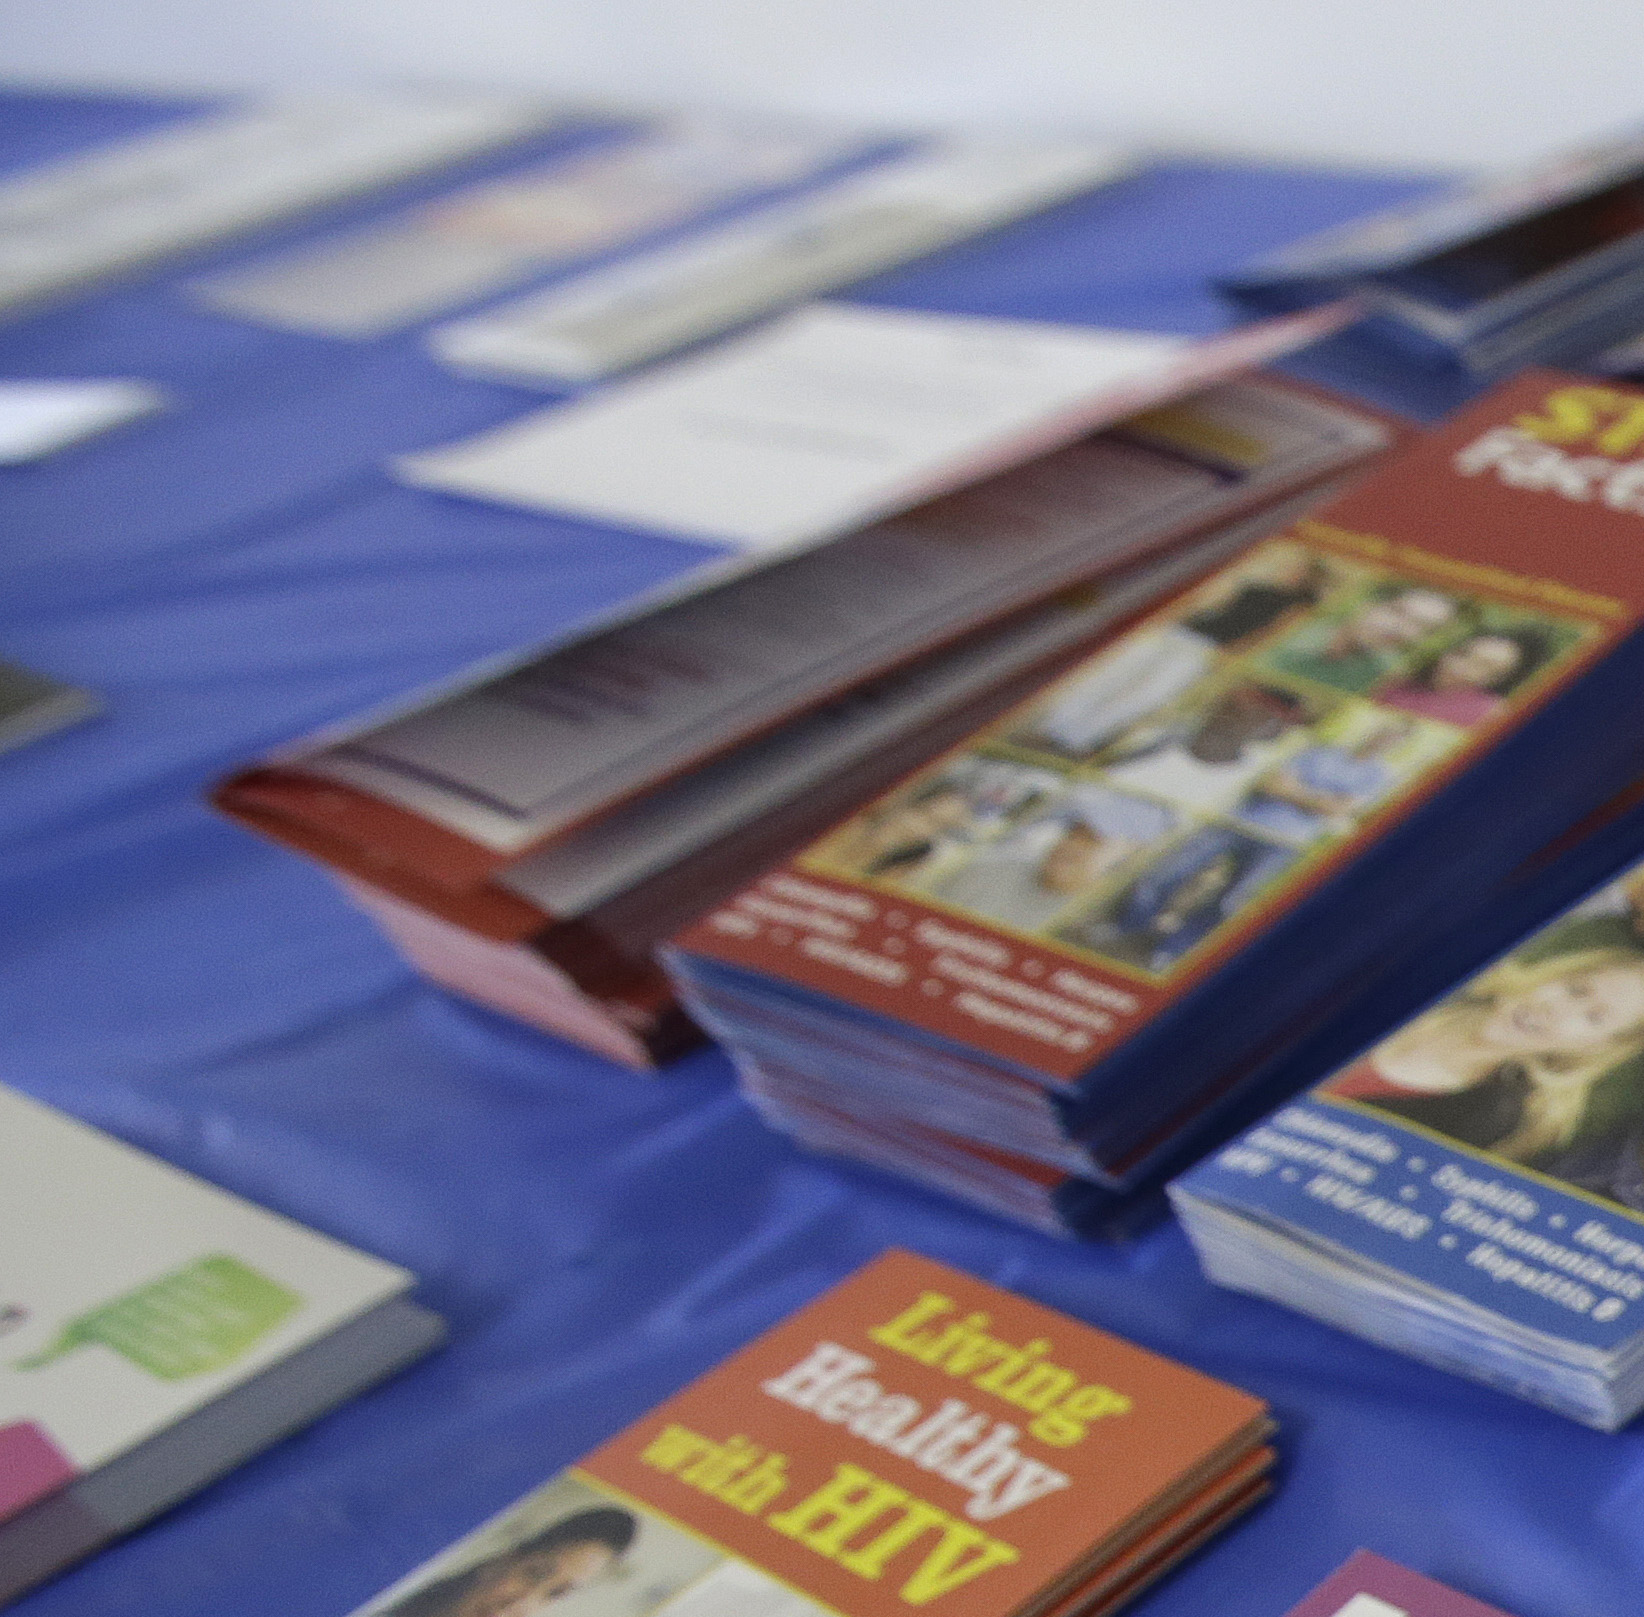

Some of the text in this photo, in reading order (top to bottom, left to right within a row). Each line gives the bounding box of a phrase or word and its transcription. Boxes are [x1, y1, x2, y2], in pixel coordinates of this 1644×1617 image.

[762, 1340, 1071, 1521] Healthy
[868, 1290, 1132, 1447] Living
[641, 1423, 1020, 1607] with HIV
